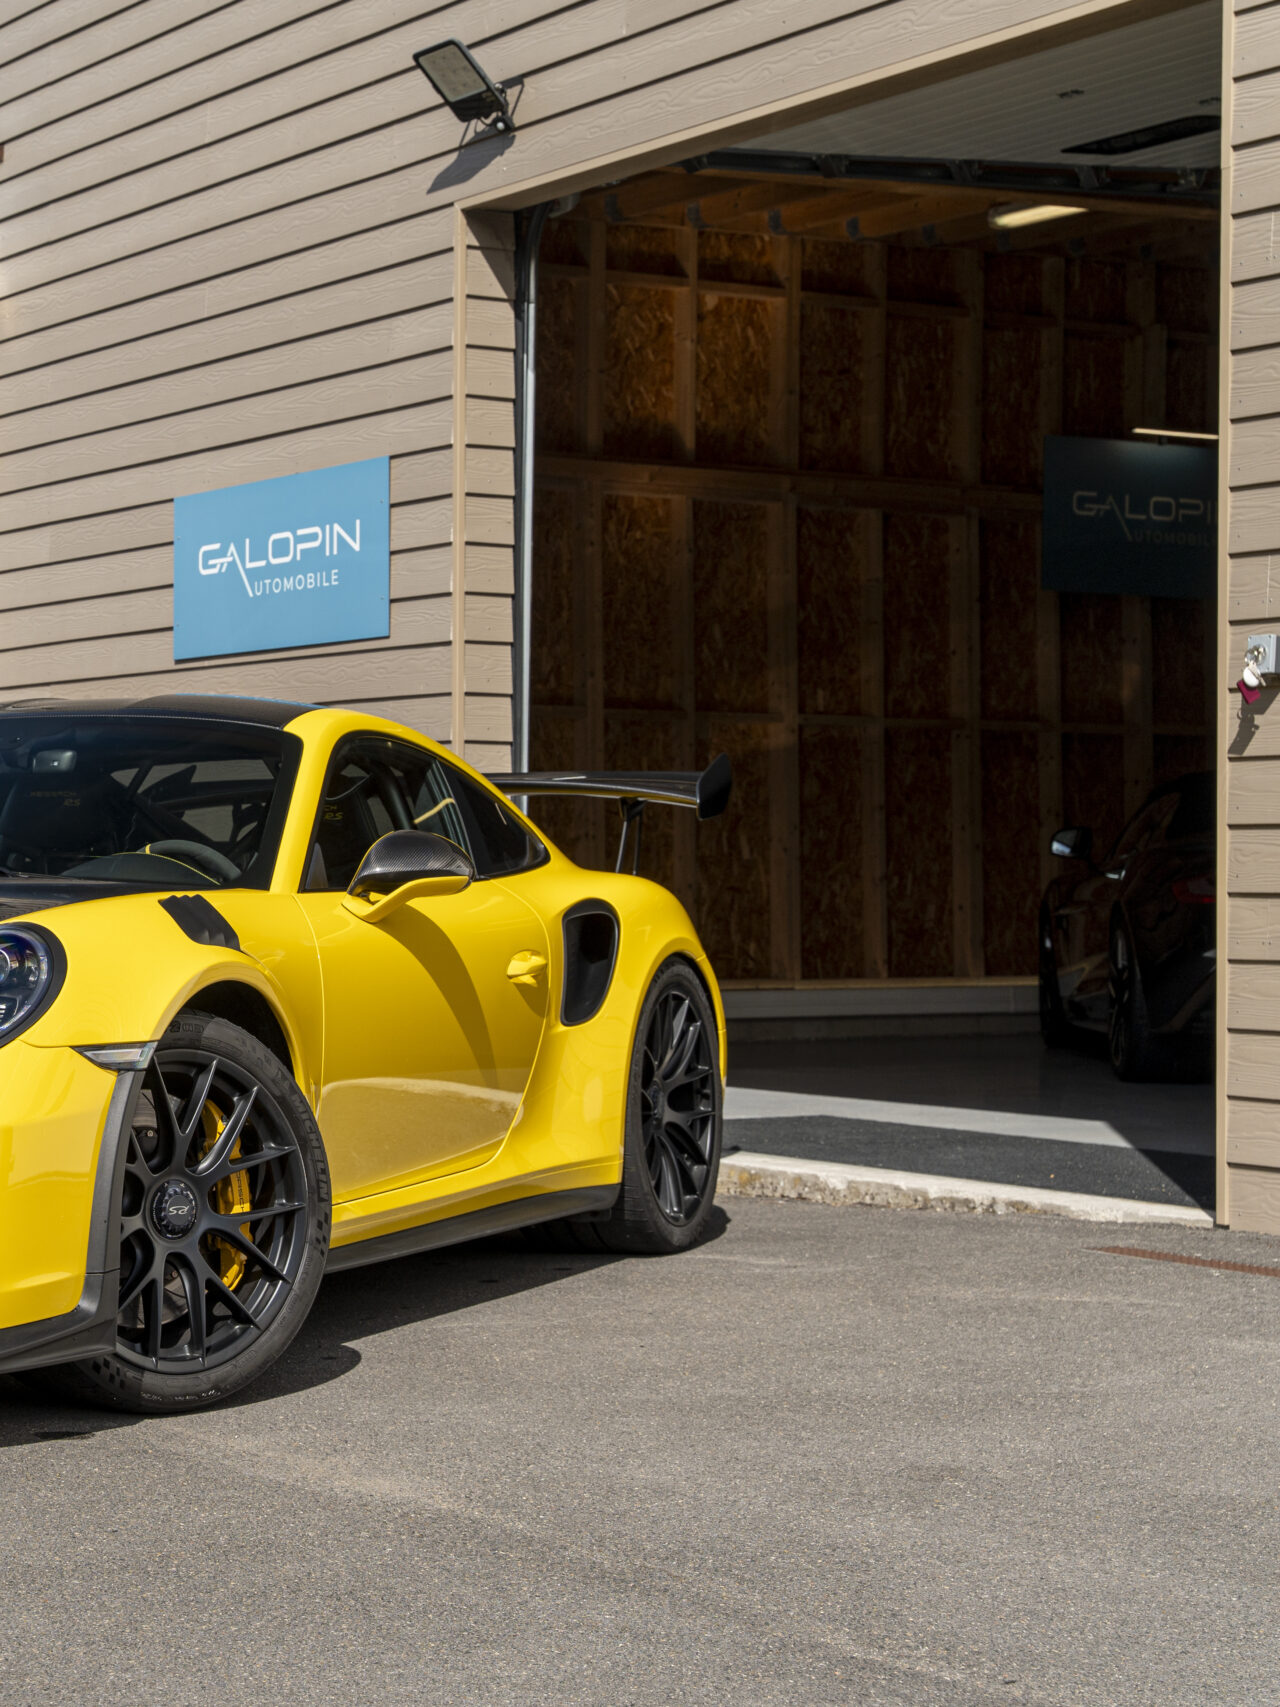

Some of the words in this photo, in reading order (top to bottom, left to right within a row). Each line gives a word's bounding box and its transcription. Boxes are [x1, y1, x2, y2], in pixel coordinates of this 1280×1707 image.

[1072, 491, 1217, 541] GALOPI
[198, 519, 360, 597] GALOPIN
[292, 1095, 329, 1202] MICHELIN
